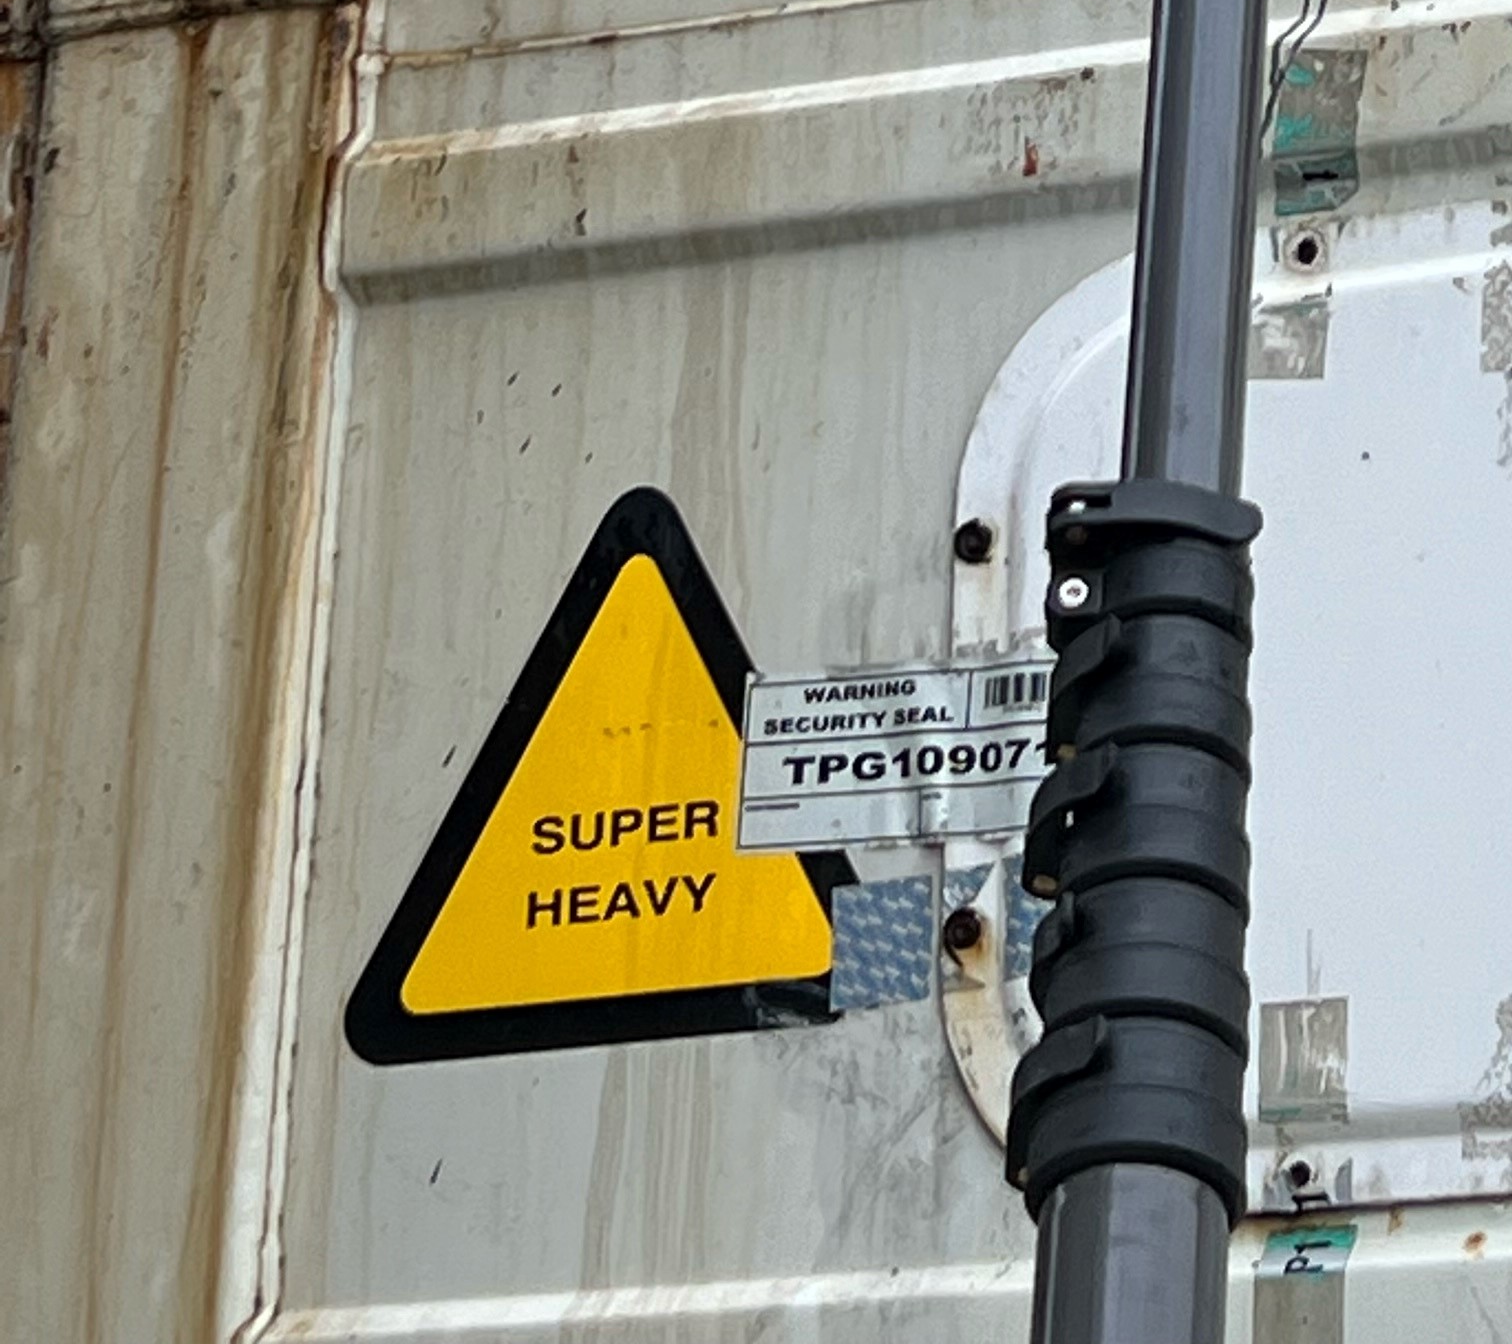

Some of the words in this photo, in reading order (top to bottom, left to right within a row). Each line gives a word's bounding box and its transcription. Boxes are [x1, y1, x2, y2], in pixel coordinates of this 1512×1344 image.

[803, 678, 918, 704] WARNING
[763, 710, 887, 736] SECURITY
[892, 705, 955, 726] SEAL
[532, 799, 720, 855] SUPER
[526, 872, 717, 930] HEAVY
